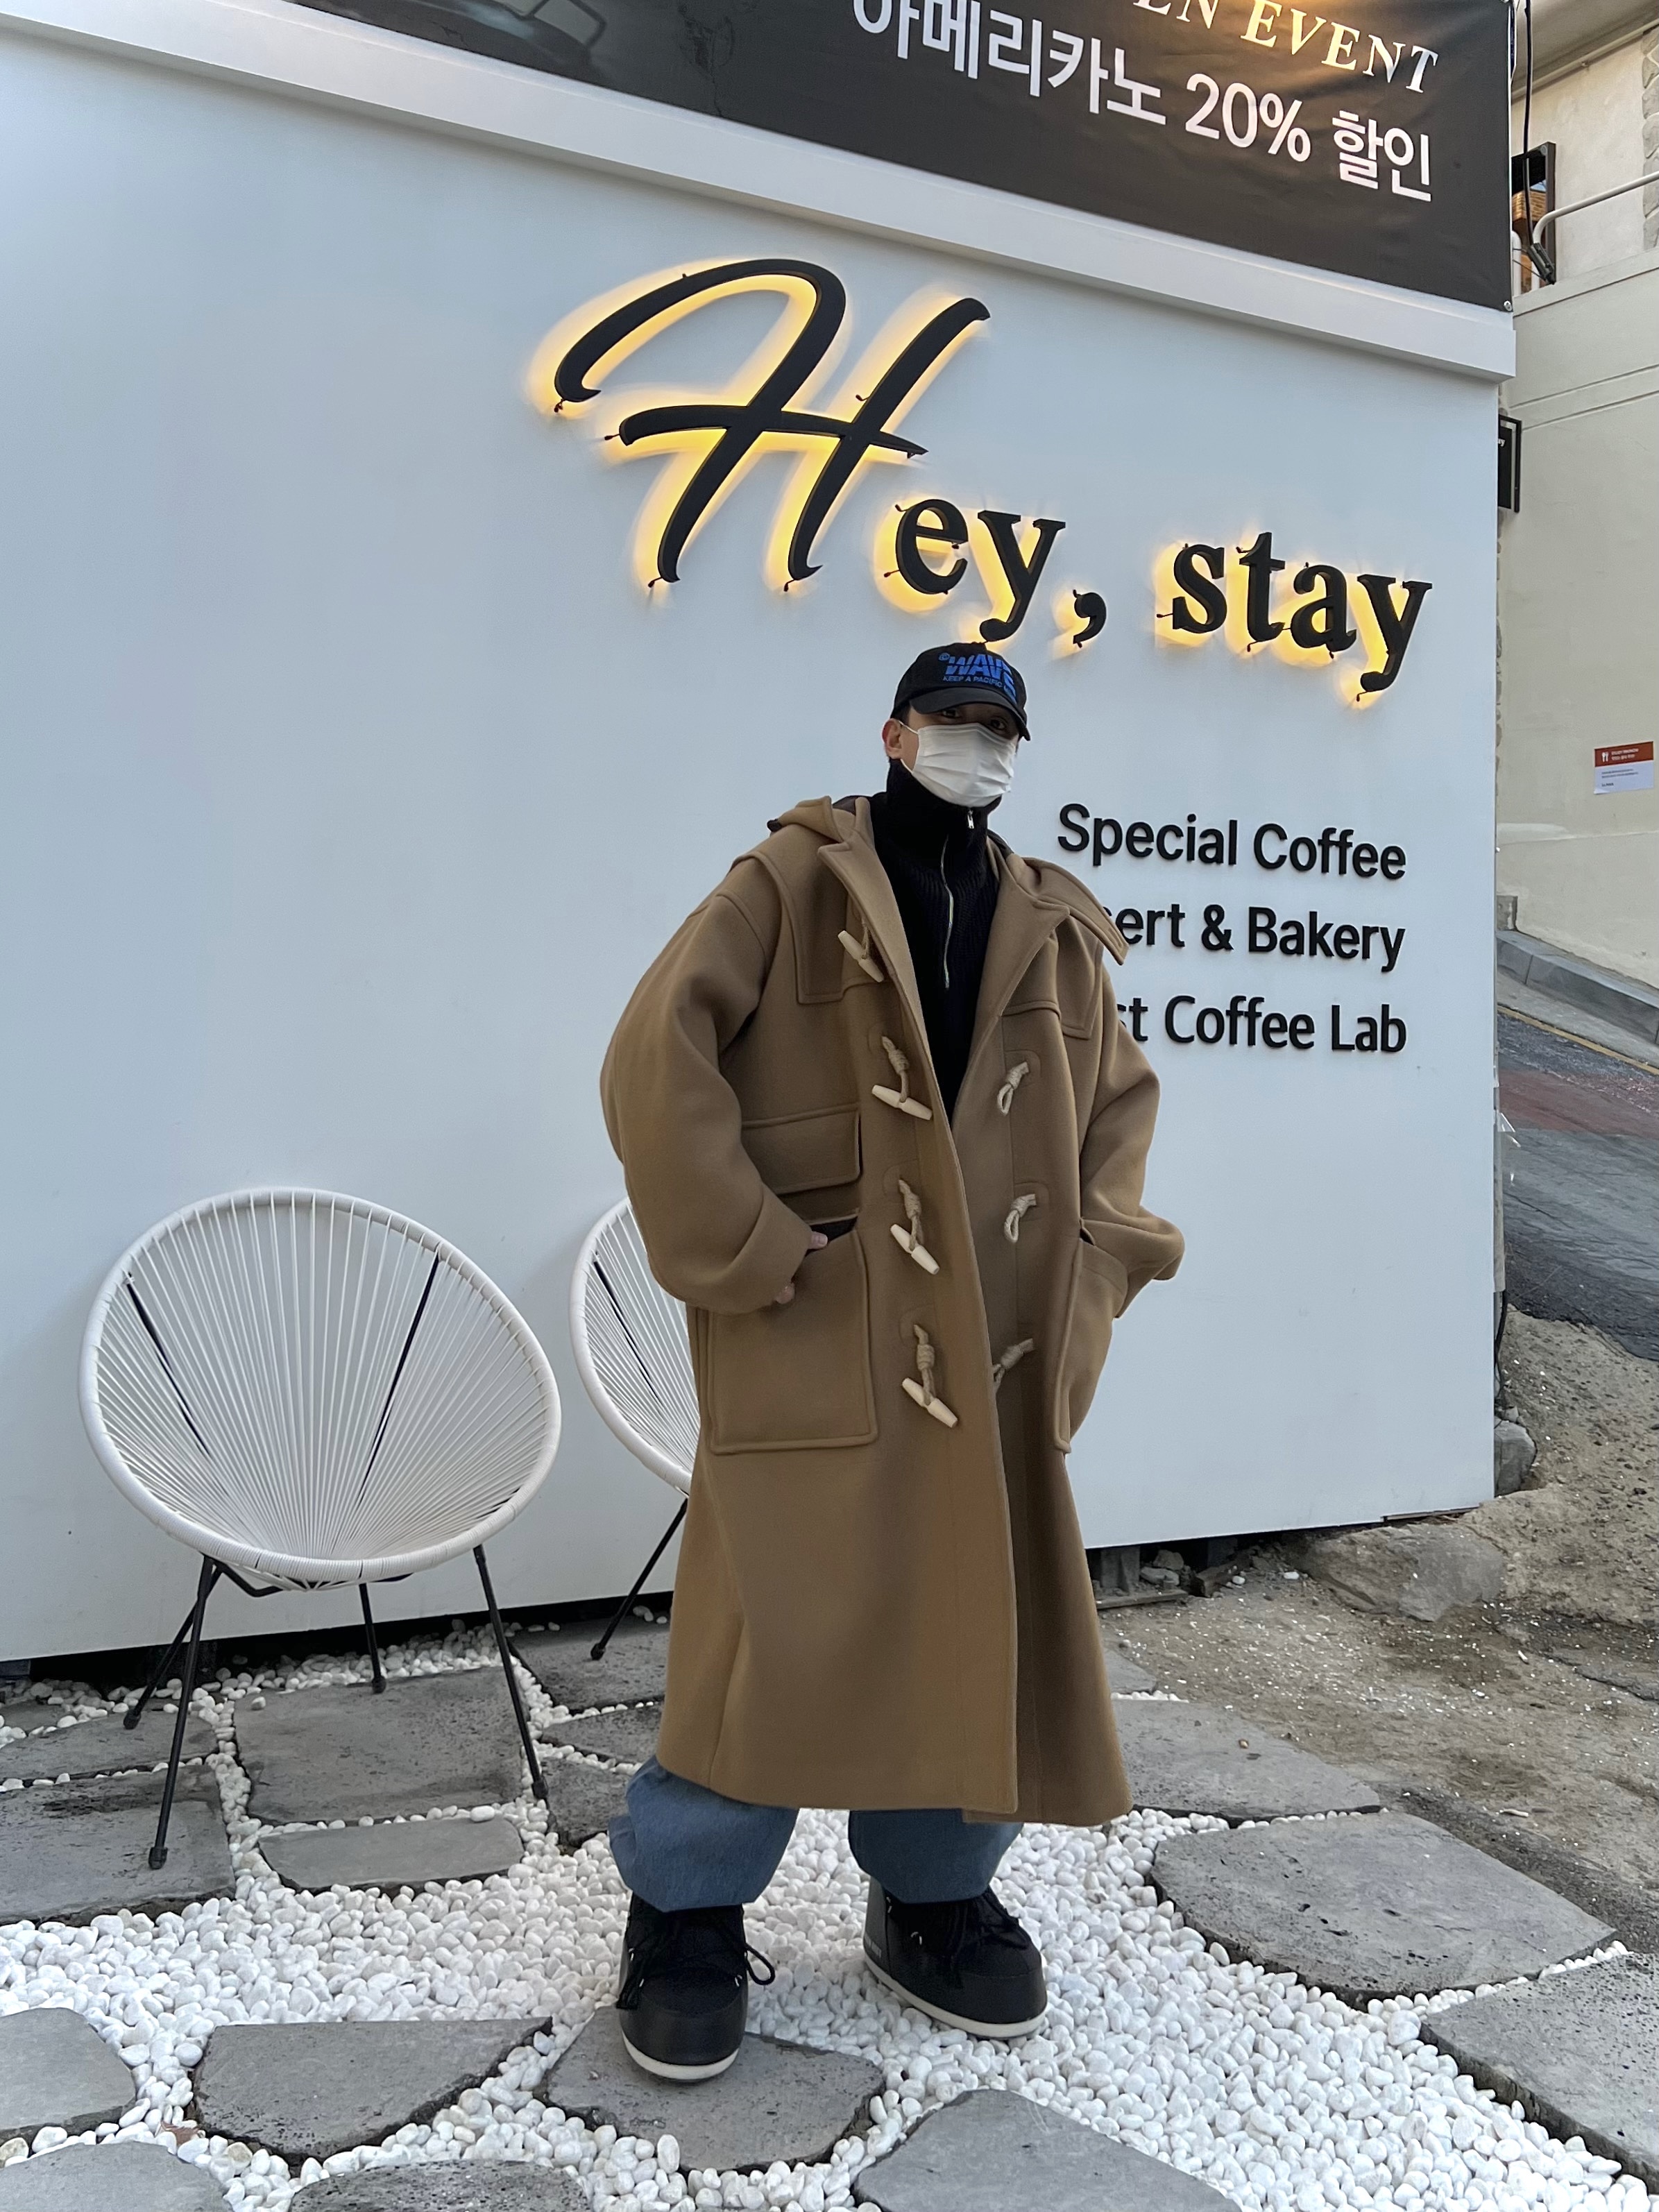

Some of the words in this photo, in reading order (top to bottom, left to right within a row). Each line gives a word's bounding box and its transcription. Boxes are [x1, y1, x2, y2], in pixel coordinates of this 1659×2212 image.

[1240, 0, 1439, 94] EVENT
[853, 0, 1166, 126] 아메리카노
[1185, 73, 1311, 162] 20%
[1332, 110, 1432, 202] 할인
[554, 258, 1107, 645] Hey,
[1171, 531, 1433, 692] stay
[1057, 803, 1238, 867] Special
[1253, 823, 1406, 880] Coffee
[1104, 903, 1185, 948] ert
[1201, 904, 1234, 951] &
[1248, 906, 1406, 972] Bakery
[1164, 995, 1315, 1049] Coffee
[1331, 1003, 1407, 1053] Lab
